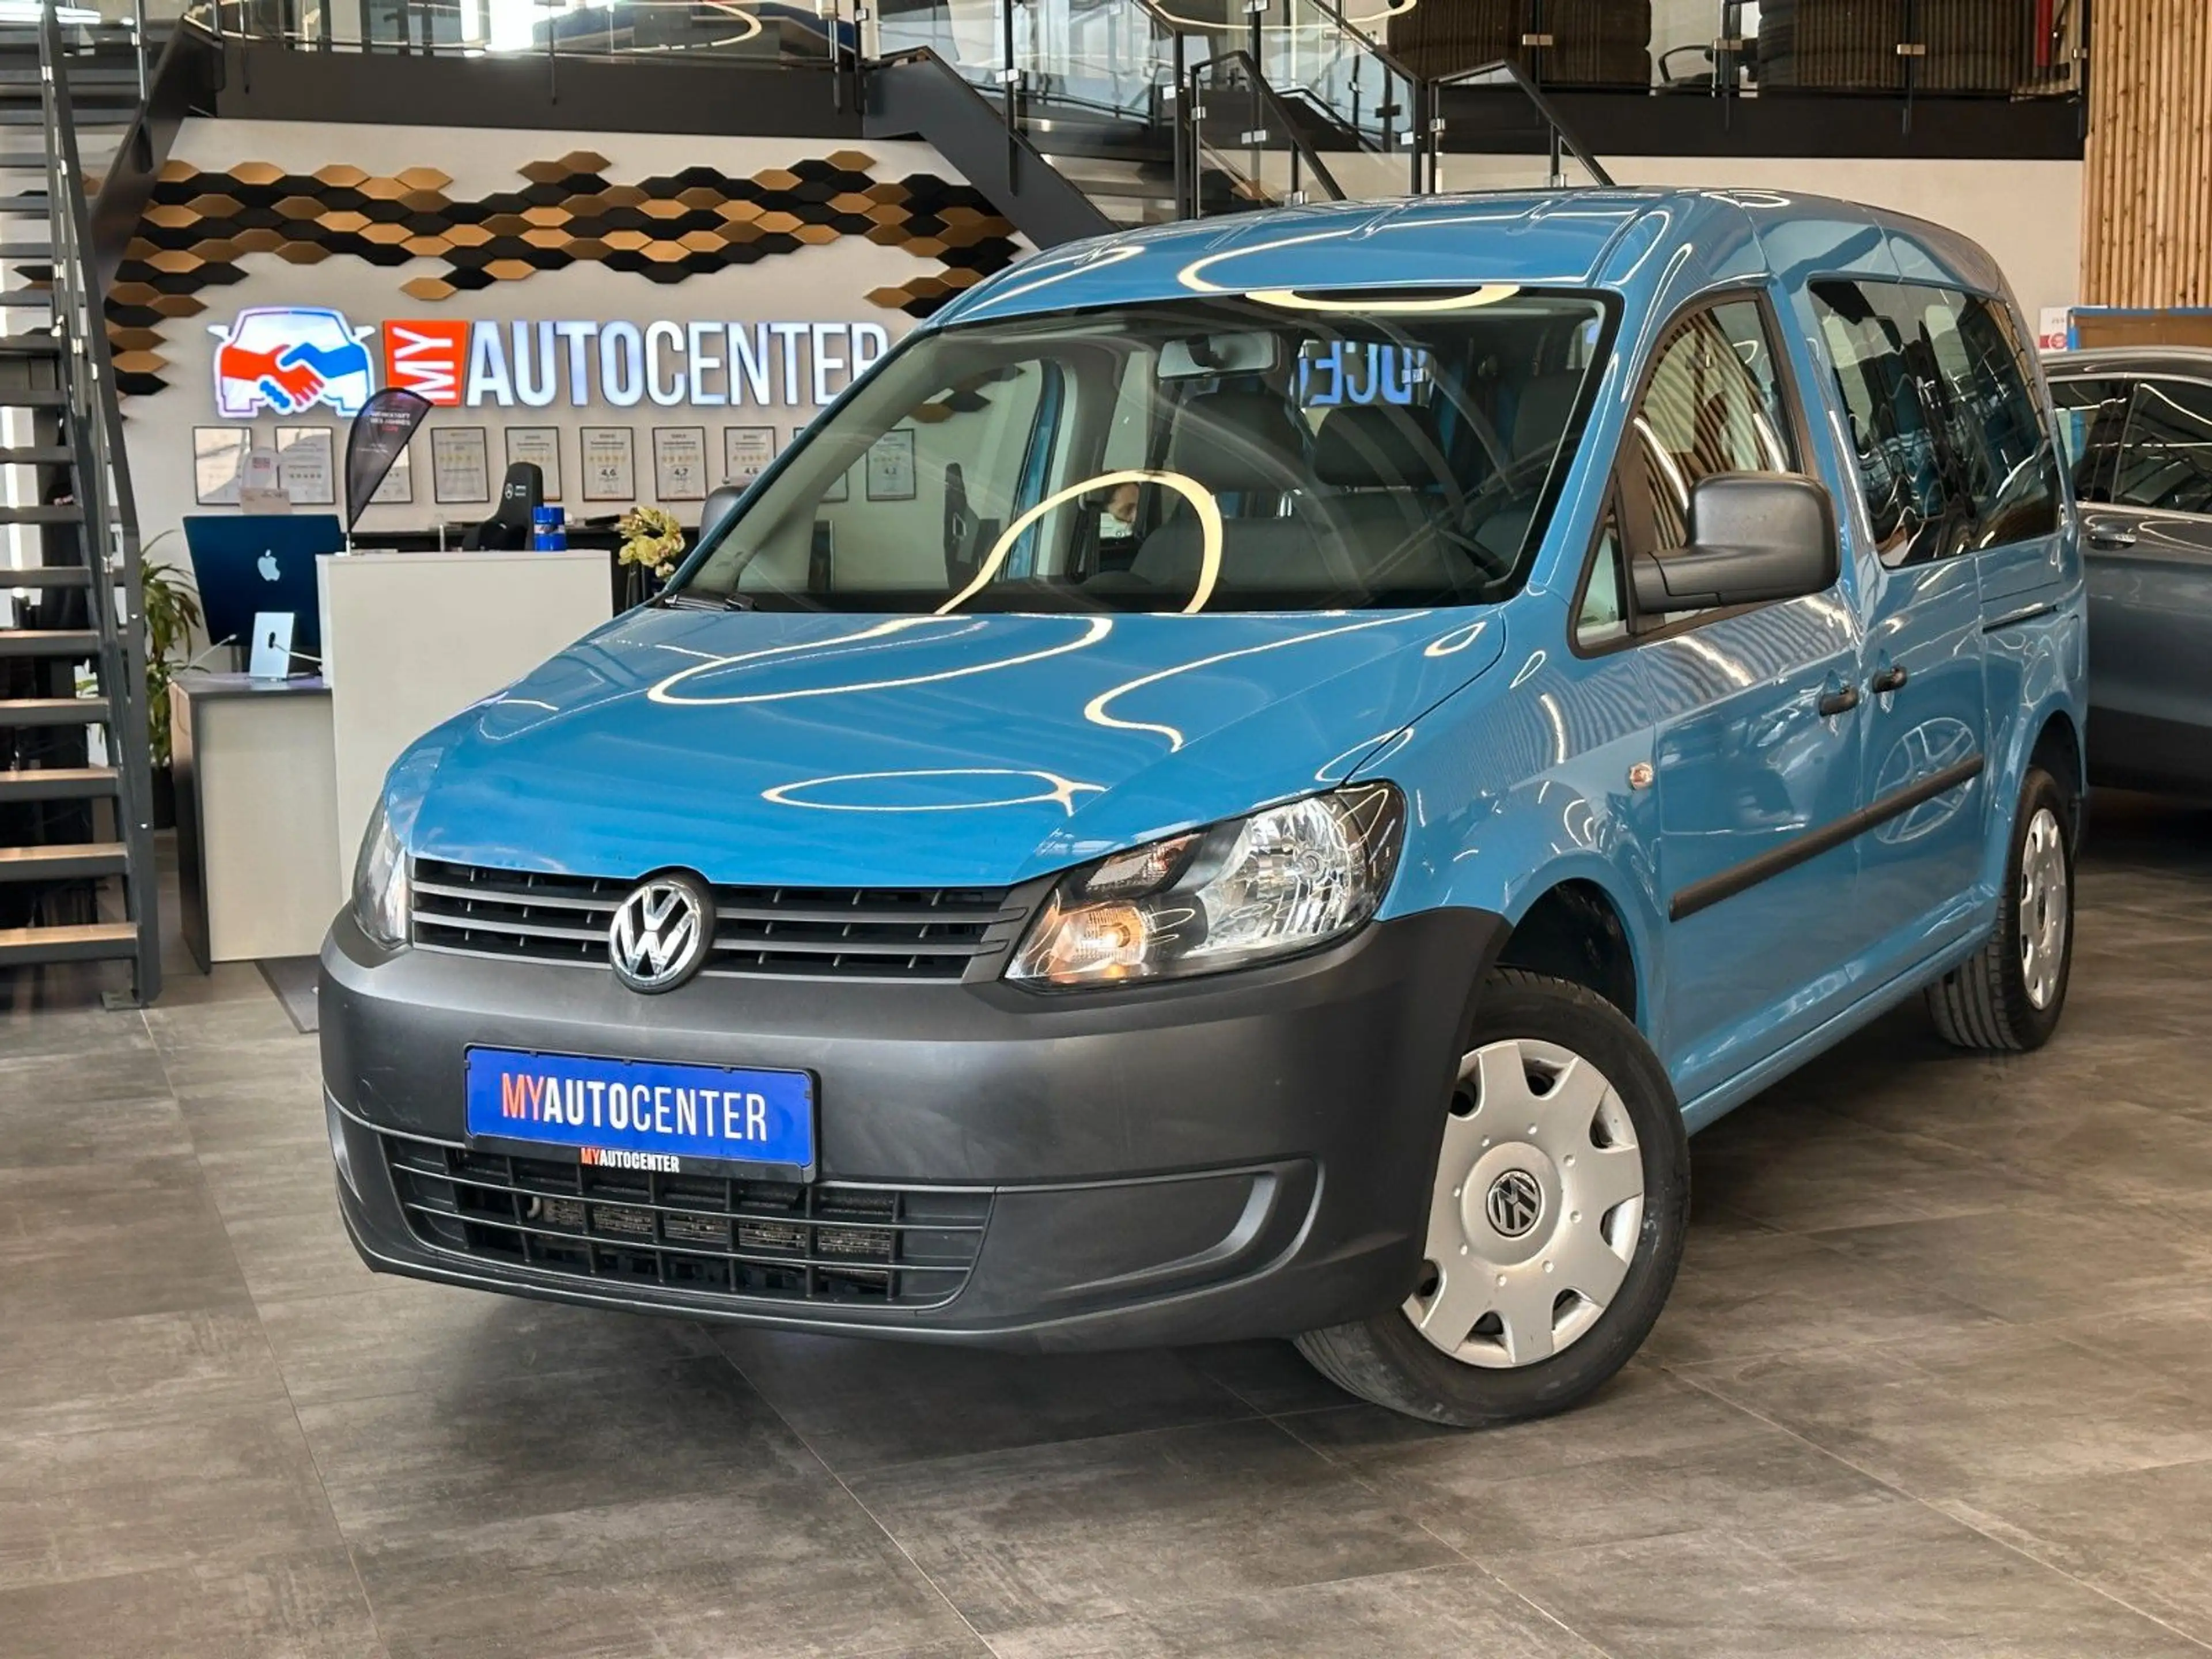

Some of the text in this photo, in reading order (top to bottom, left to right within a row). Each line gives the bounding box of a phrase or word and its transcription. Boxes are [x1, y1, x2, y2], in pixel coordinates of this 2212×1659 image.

[392, 325, 455, 400] MY
[502, 1073, 767, 1141] MYAUTOCENTER
[581, 1147, 680, 1173] MYAUTOCENTER
